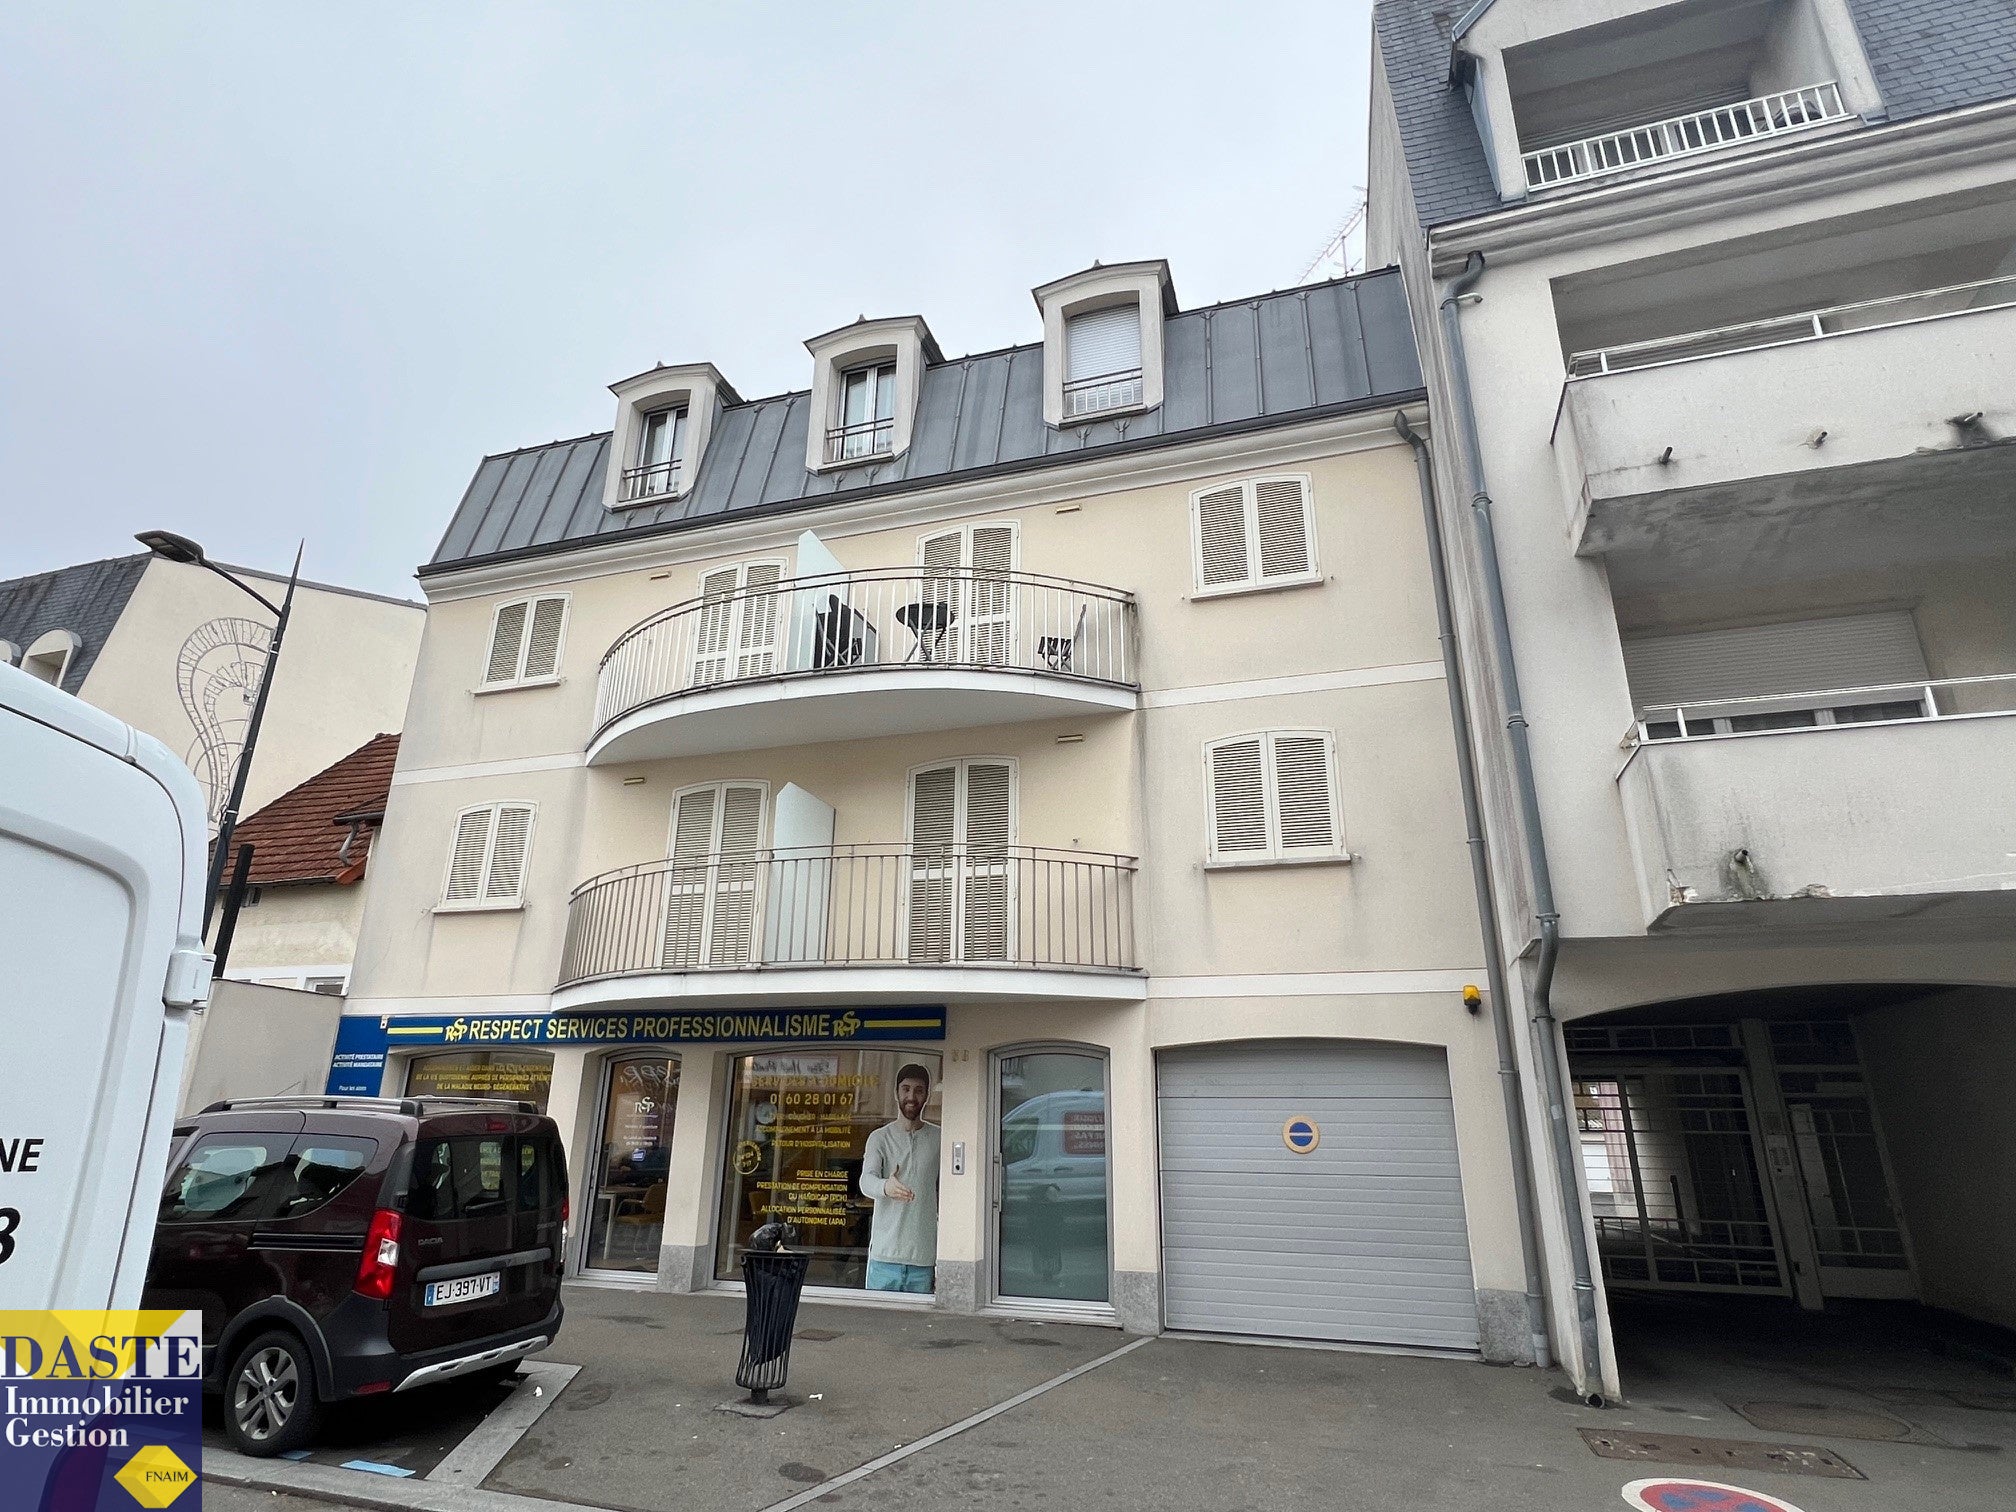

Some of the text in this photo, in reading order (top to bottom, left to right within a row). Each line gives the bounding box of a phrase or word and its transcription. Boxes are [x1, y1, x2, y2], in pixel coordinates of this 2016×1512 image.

[469, 1018, 543, 1040] RESPECT
[546, 1017, 628, 1039] SERVICES
[632, 1014, 831, 1039] PROFESSIONNALISME
[770, 1093, 853, 1105] 01 60 28 01 67
[796, 1170, 849, 1178] PRISE EN CHARGE
[756, 1181, 790, 1190] PRESTATION
[800, 1182, 848, 1191] COMPENSATION
[788, 1192, 798, 1200] DU
[761, 1205, 846, 1215] ALLOCATION PERSONNALISÉE
[787, 1216, 847, 1226] D'AUTONOMIE (APA)
